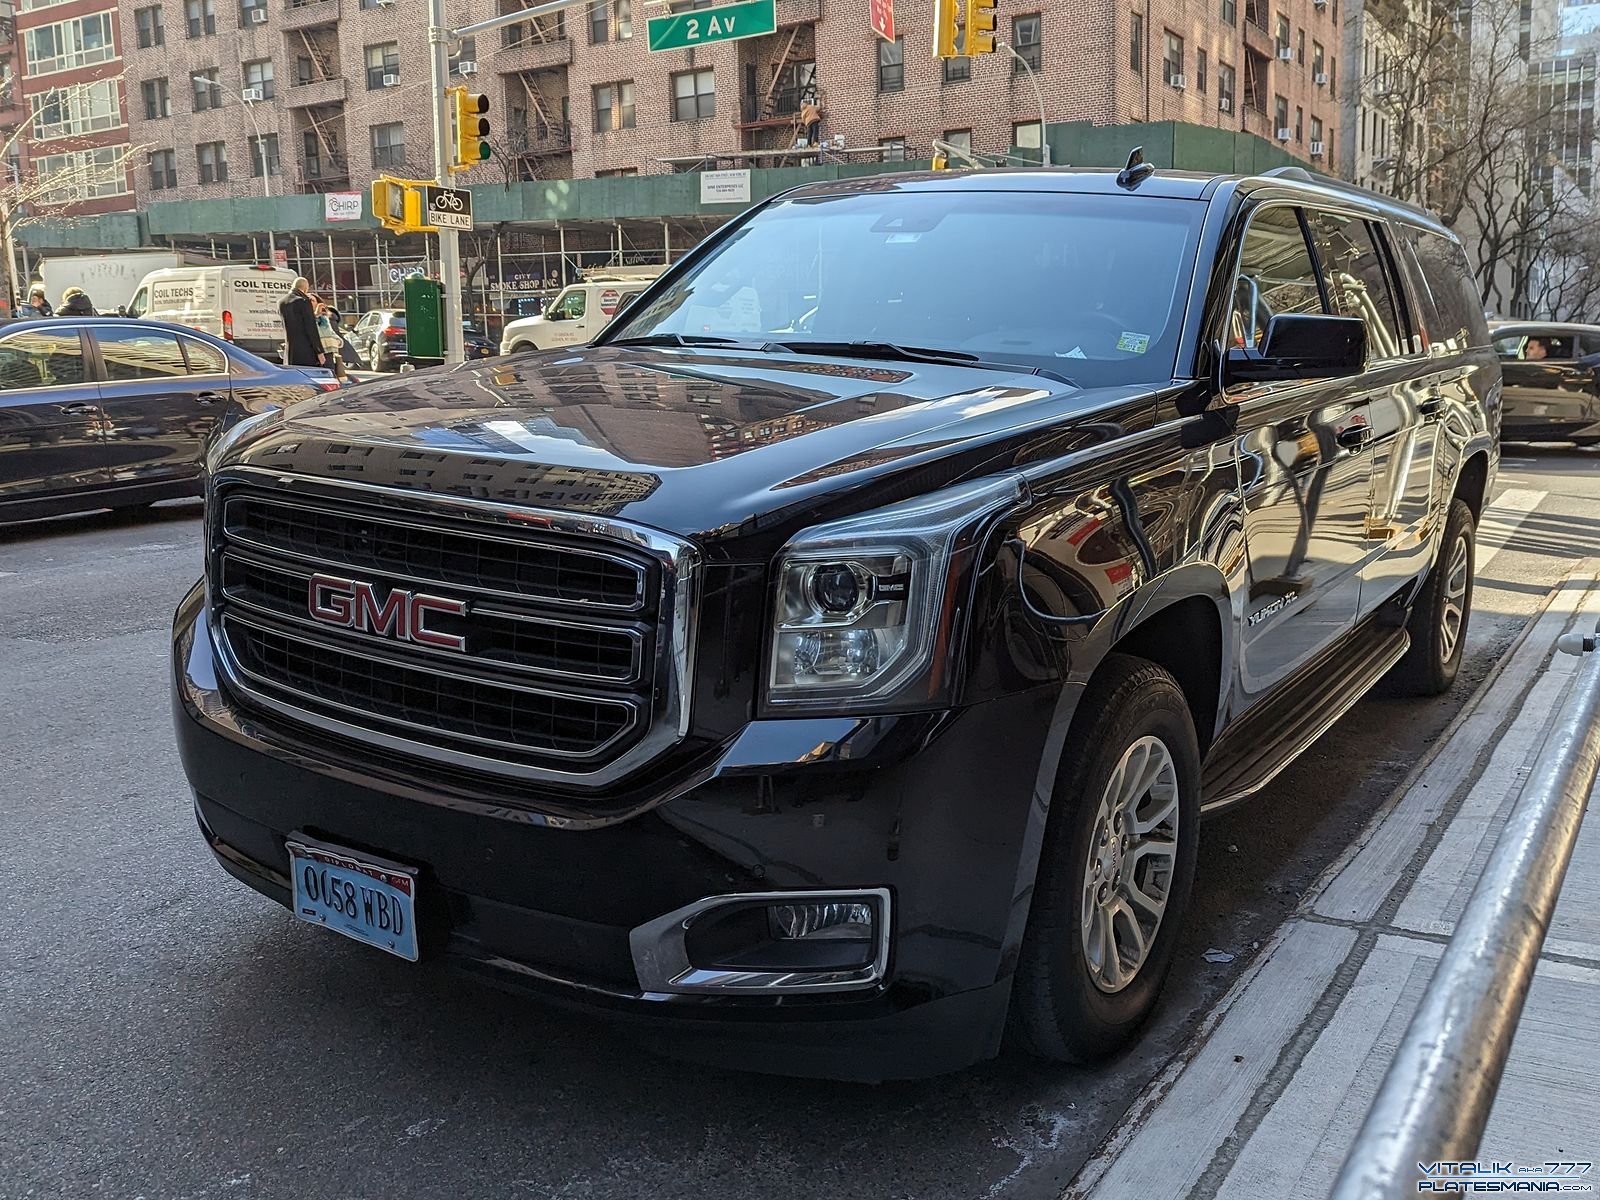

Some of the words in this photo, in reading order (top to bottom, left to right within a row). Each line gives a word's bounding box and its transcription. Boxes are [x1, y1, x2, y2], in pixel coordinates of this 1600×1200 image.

[686, 19, 699, 39] 2
[707, 15, 736, 36] Av
[330, 198, 359, 212] CHIRP
[430, 213, 448, 224] BIKE
[450, 215, 470, 226] LANE
[262, 282, 292, 290] TECHS
[490, 280, 518, 290] SMOKE
[518, 280, 540, 290] SHOP
[542, 279, 558, 288] INC.
[154, 289, 170, 298] COIL
[171, 288, 194, 296] TECHS
[309, 573, 466, 652] GMC
[1248, 597, 1284, 626] YUKON
[1284, 591, 1298, 606] XL
